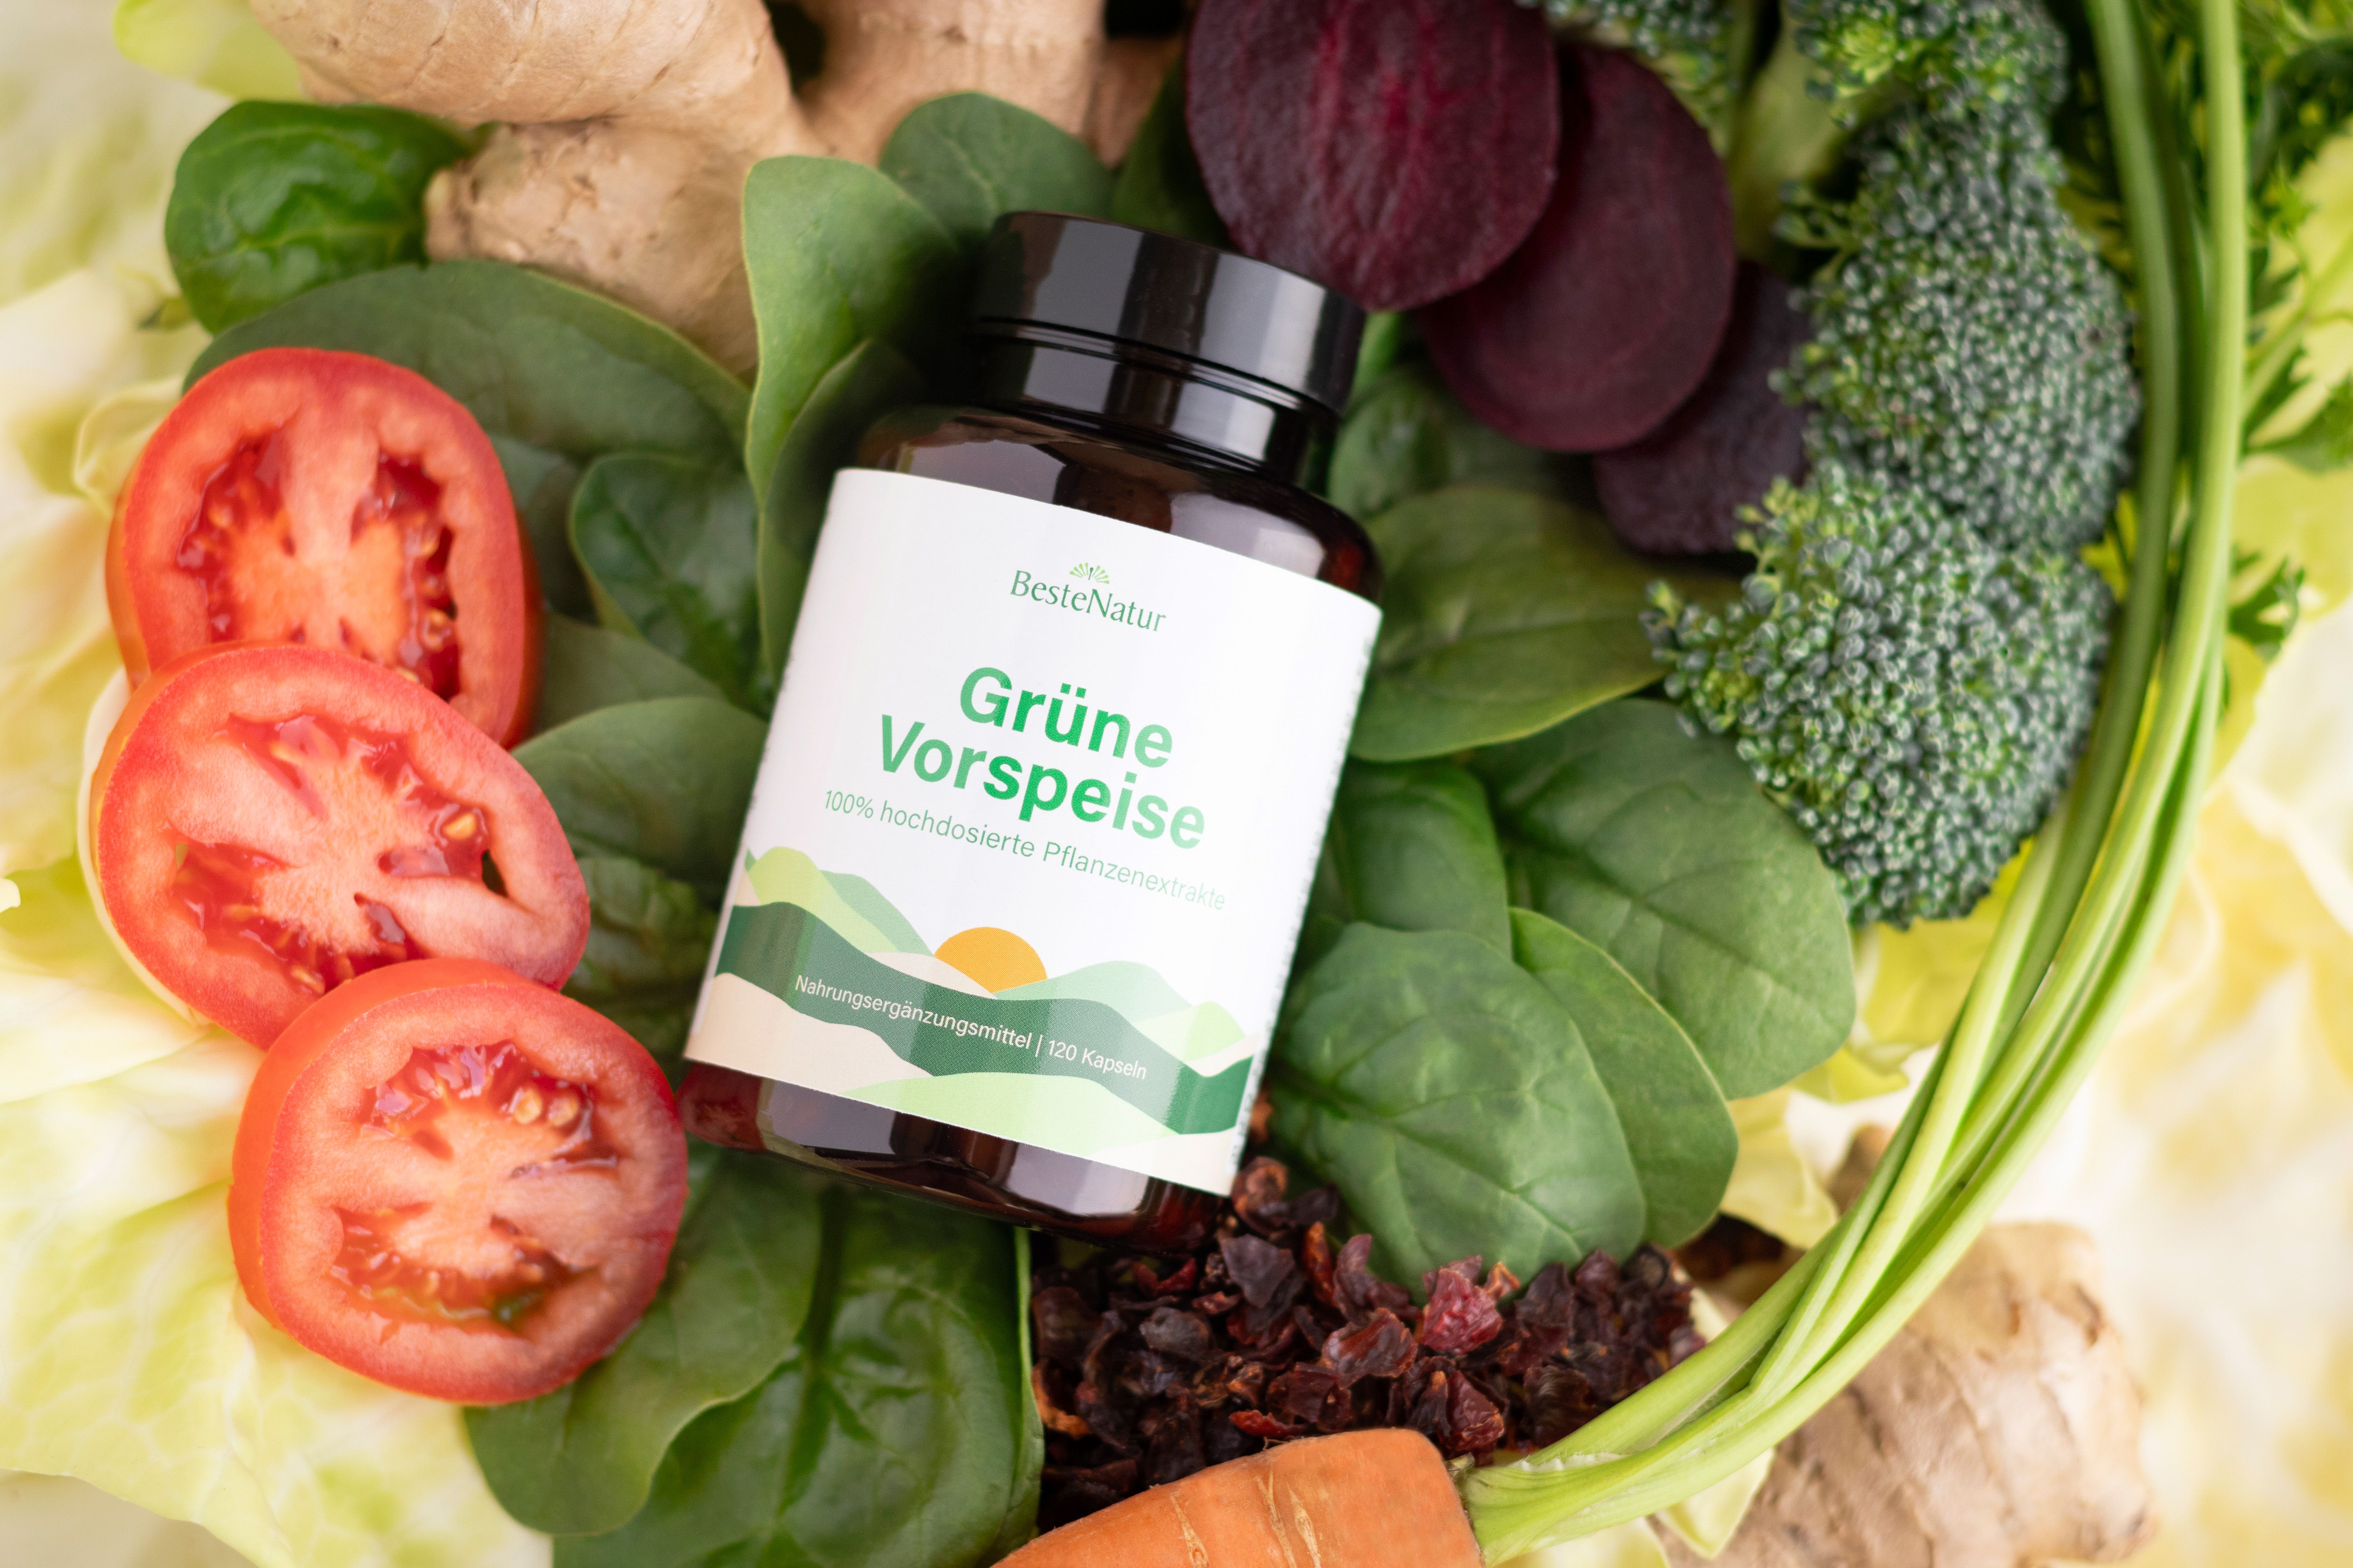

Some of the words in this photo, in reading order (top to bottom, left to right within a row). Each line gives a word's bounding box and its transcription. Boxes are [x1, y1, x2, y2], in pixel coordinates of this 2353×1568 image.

[1010, 570, 1166, 631] BesteNatur
[960, 667, 1173, 768] Grüne
[881, 714, 1205, 849] Vorspeise
[825, 790, 873, 819] 100%
[881, 801, 1034, 857] hochdosierte
[1043, 841, 1225, 910] Pflanzenextrakte
[795, 975, 1033, 1049] Nahrungsergänzungsmittel
[1048, 1040, 1077, 1061] 120
[1081, 1048, 1147, 1079] Kapseln
